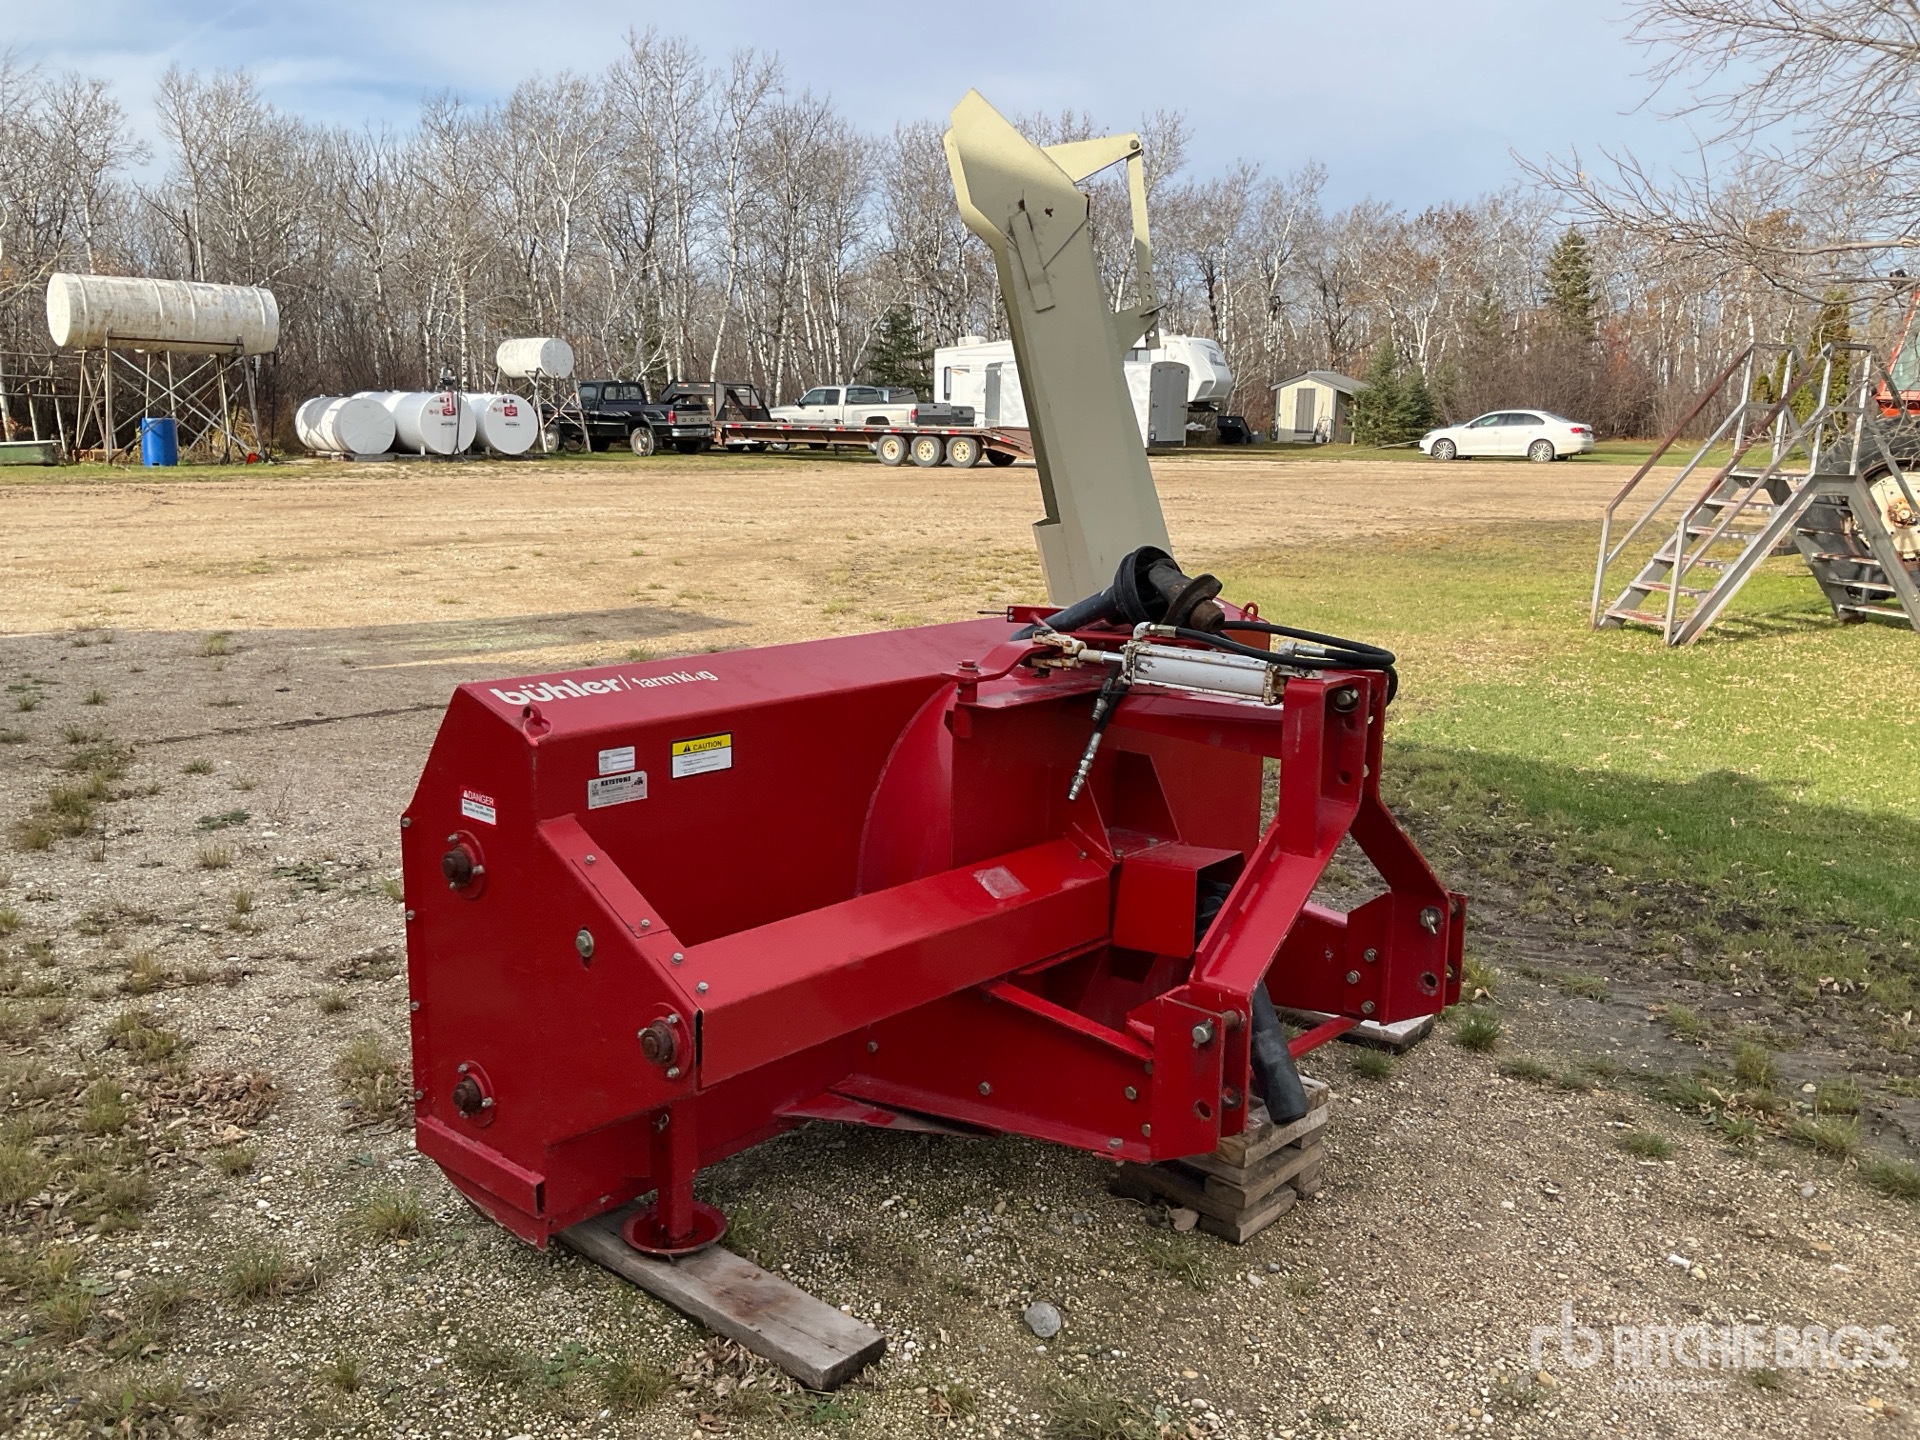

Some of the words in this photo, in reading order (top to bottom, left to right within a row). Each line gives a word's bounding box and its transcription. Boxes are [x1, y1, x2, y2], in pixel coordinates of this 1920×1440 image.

[692, 740, 723, 751] CAUTION
[600, 775, 632, 787] KEYSTONE
[468, 790, 494, 807] DANGER
